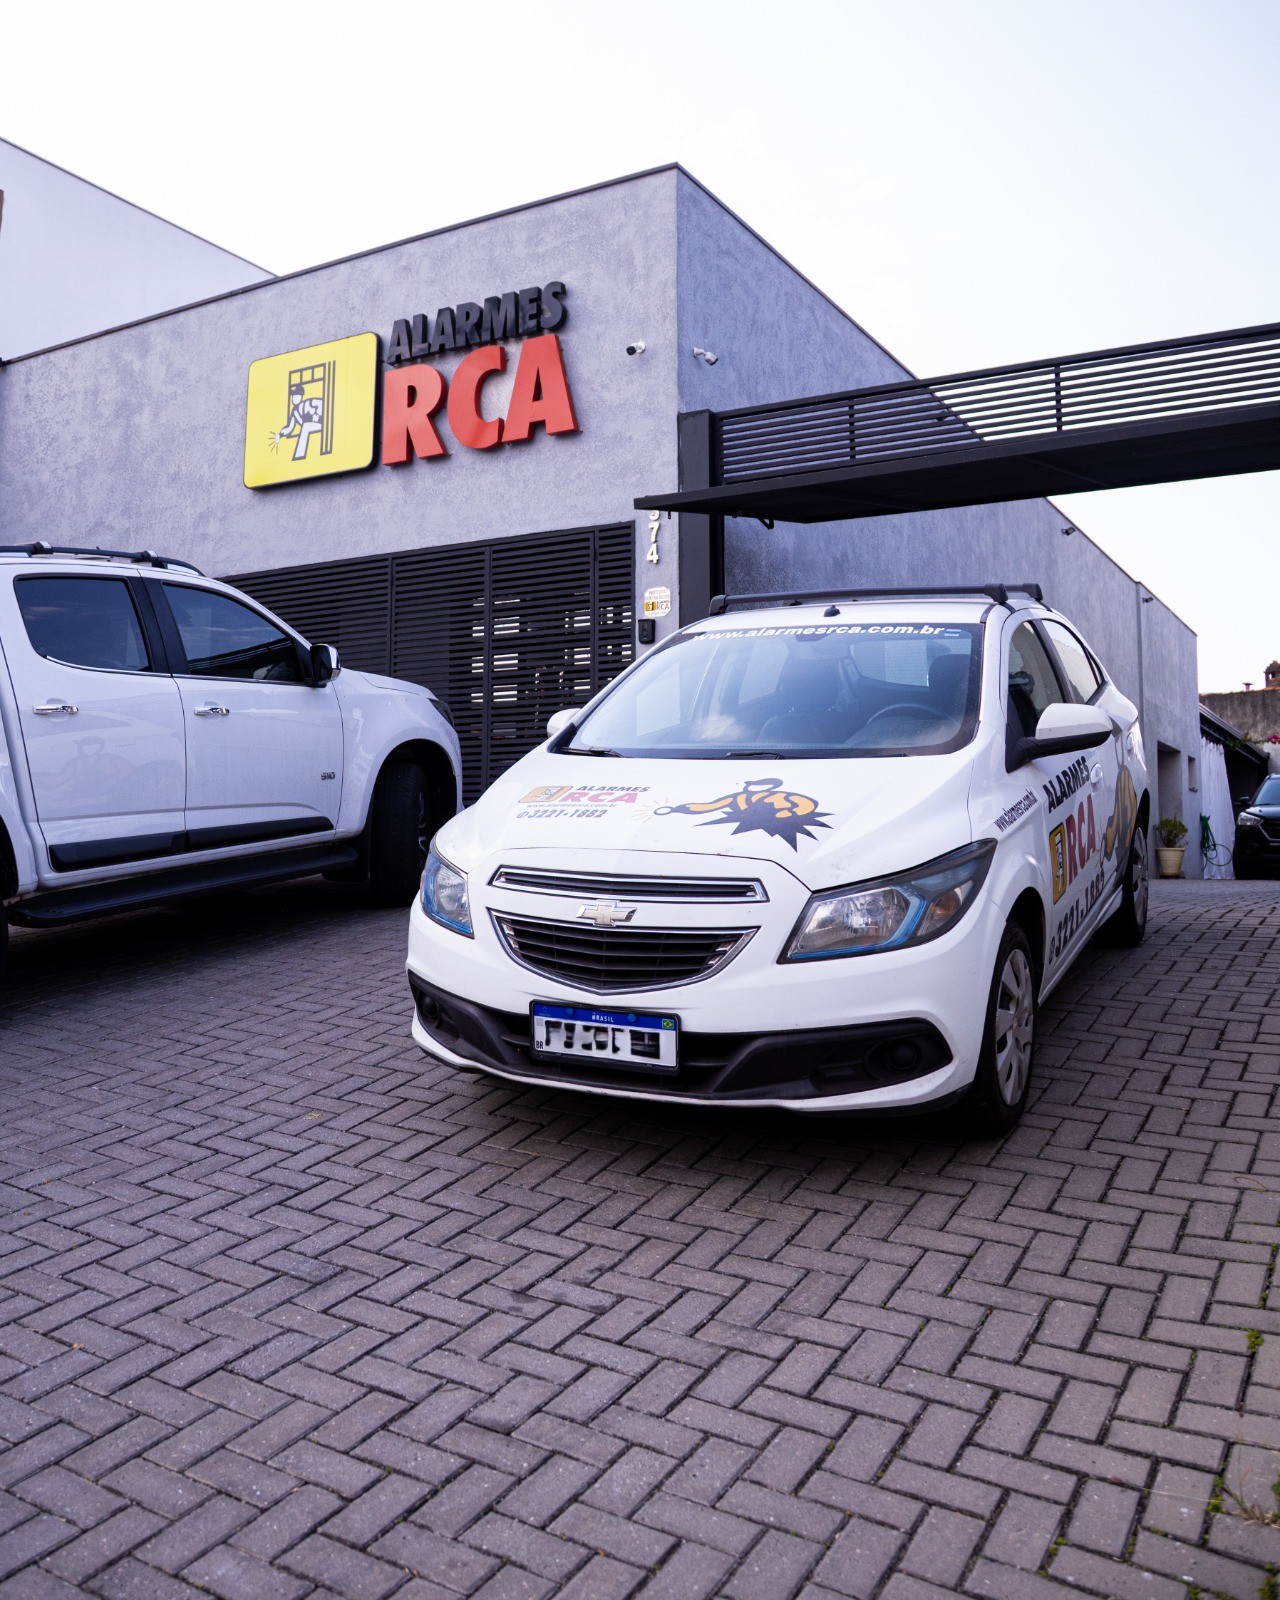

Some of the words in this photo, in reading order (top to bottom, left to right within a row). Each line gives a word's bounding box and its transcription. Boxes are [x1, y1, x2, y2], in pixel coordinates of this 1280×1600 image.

[387, 281, 568, 365] ALARMES
[382, 333, 581, 467] RCA
[693, 624, 945, 641] www.alarmesrca.com.br
[1042, 756, 1090, 814] ALARMES
[559, 792, 638, 803] RCA
[527, 809, 608, 818] 3221-1882
[1065, 793, 1096, 886] RCA
[592, 1014, 614, 1022] BRASIL
[536, 1040, 544, 1050] BR
